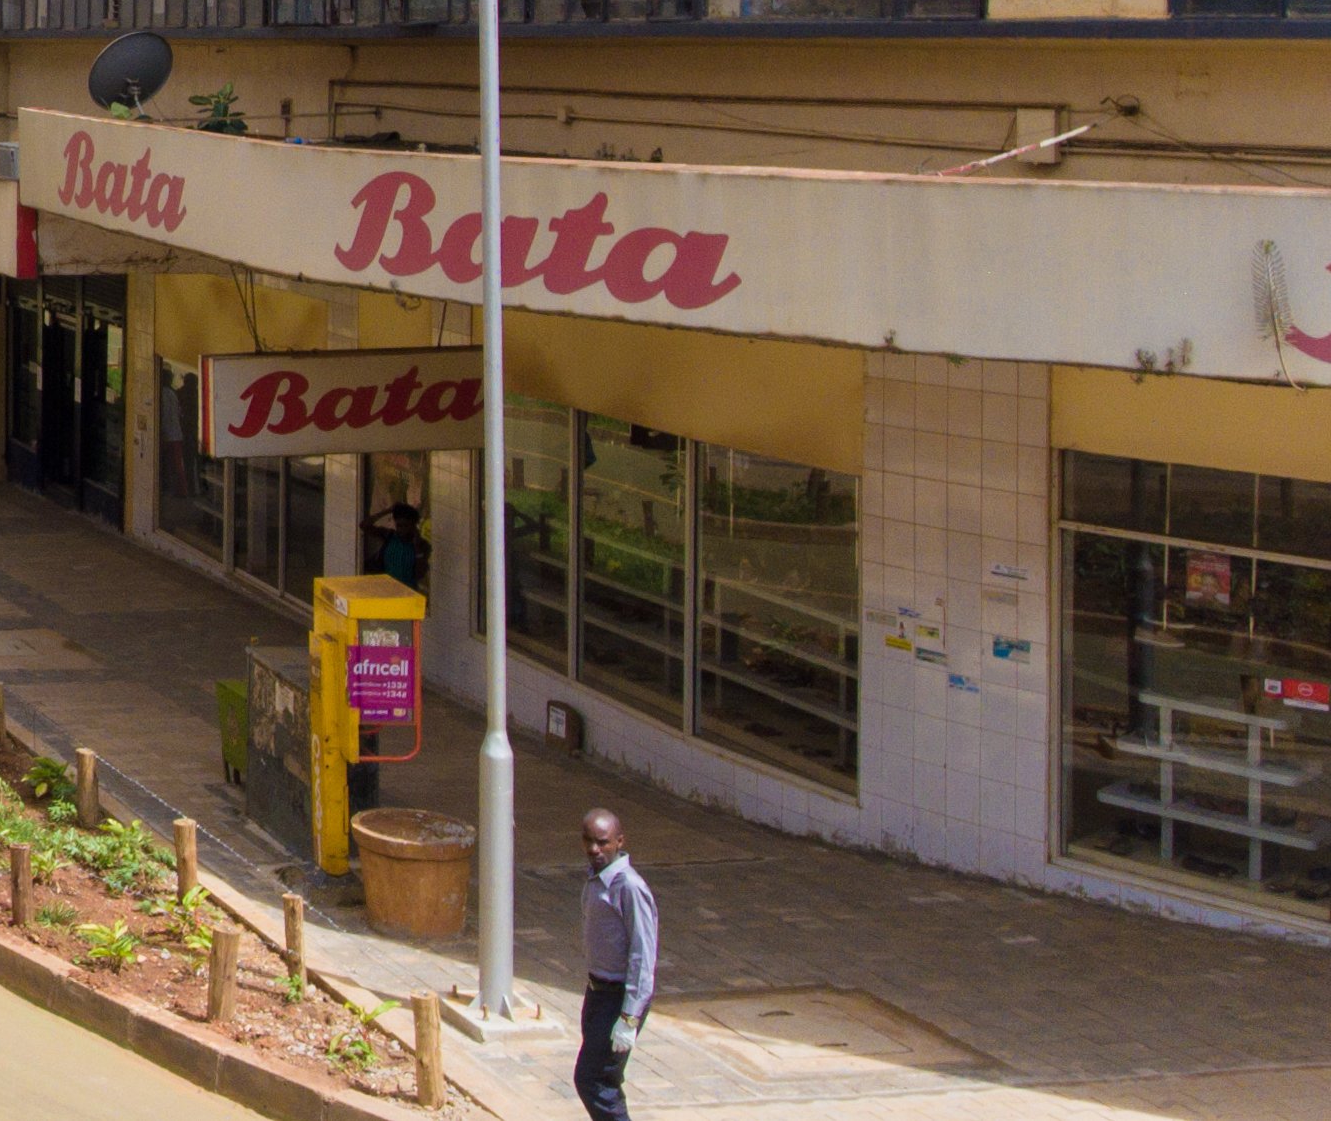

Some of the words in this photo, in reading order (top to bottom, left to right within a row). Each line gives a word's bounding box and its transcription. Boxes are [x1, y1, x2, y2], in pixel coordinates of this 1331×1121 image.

[58, 131, 187, 233] Bata
[334, 171, 739, 310] Bata
[227, 366, 482, 439] Bata
[353, 659, 409, 676] africell
